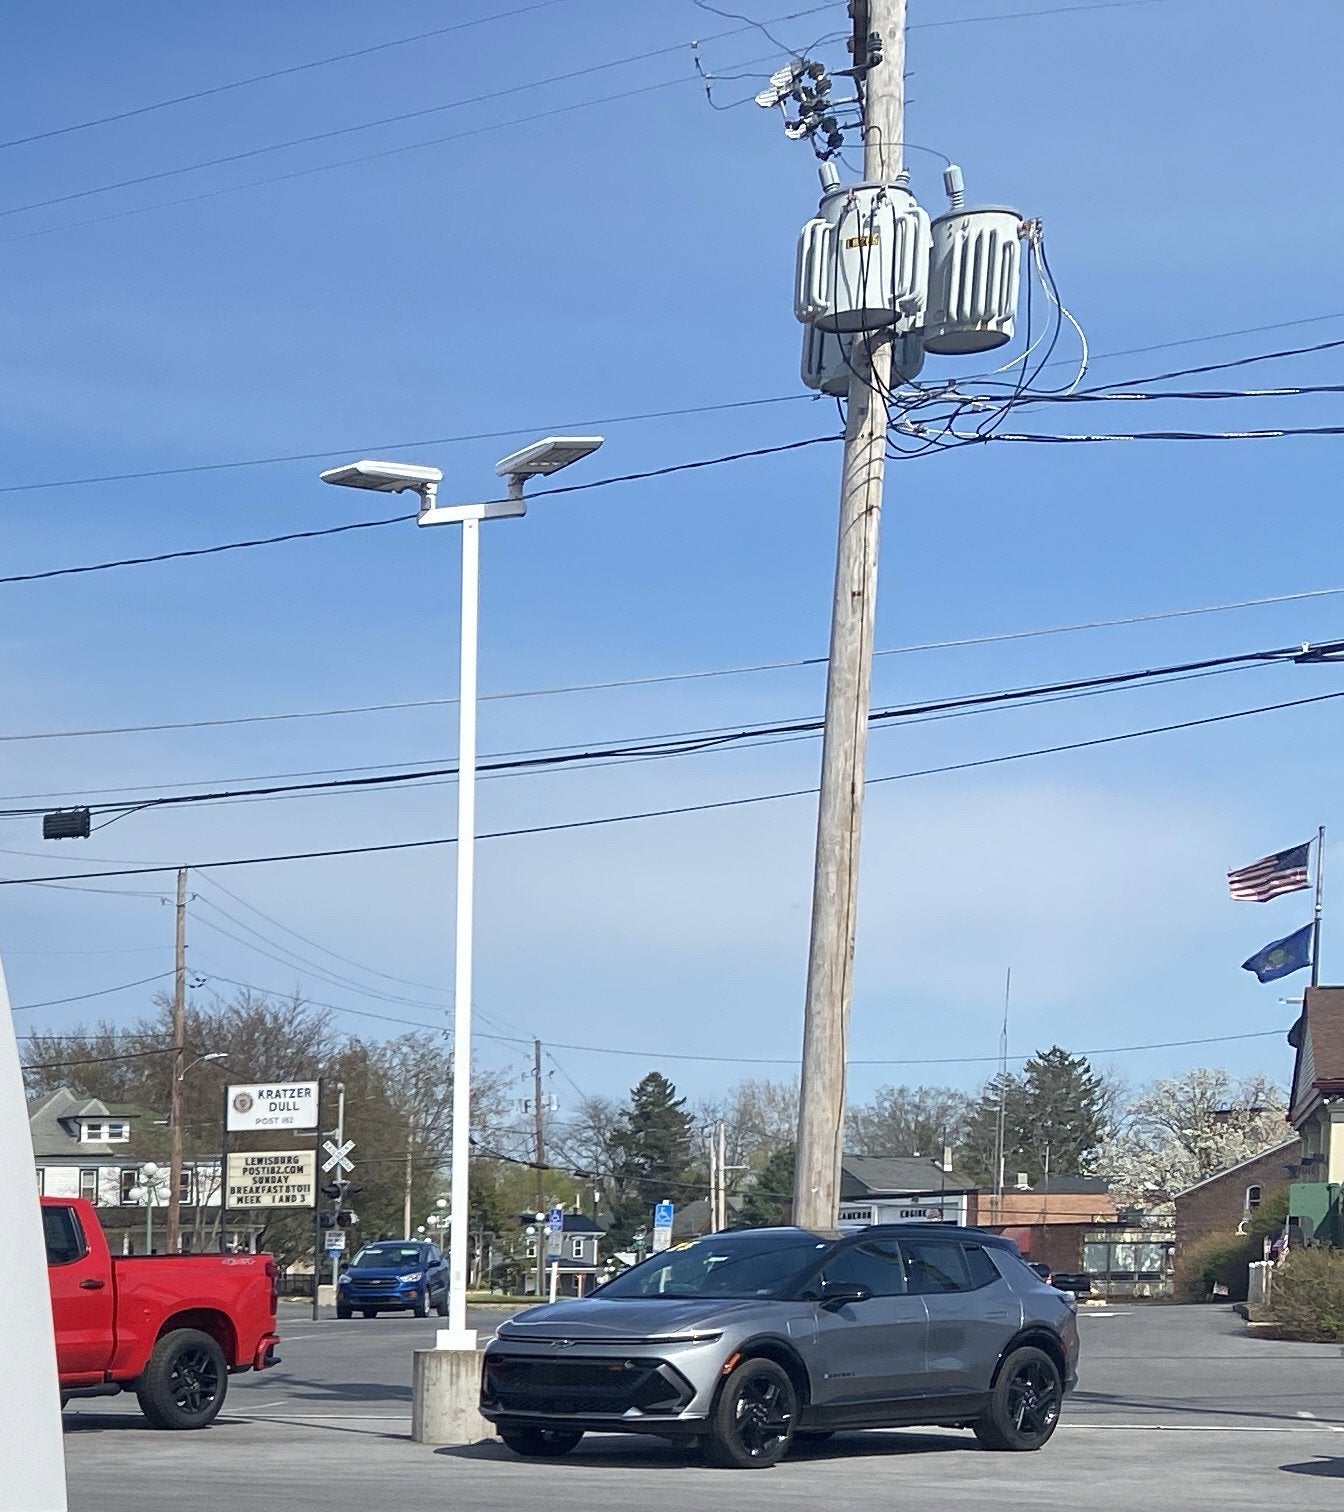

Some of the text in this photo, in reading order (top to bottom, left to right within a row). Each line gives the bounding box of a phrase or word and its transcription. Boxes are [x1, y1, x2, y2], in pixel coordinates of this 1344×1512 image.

[257, 1088, 312, 1100] KRATZER
[269, 1102, 301, 1112] DULL
[245, 1156, 299, 1166] LEWISBURG
[252, 1176, 290, 1185] SUNDAY
[236, 1196, 262, 1205] WEEK
[900, 1208, 927, 1219] ENGINE
